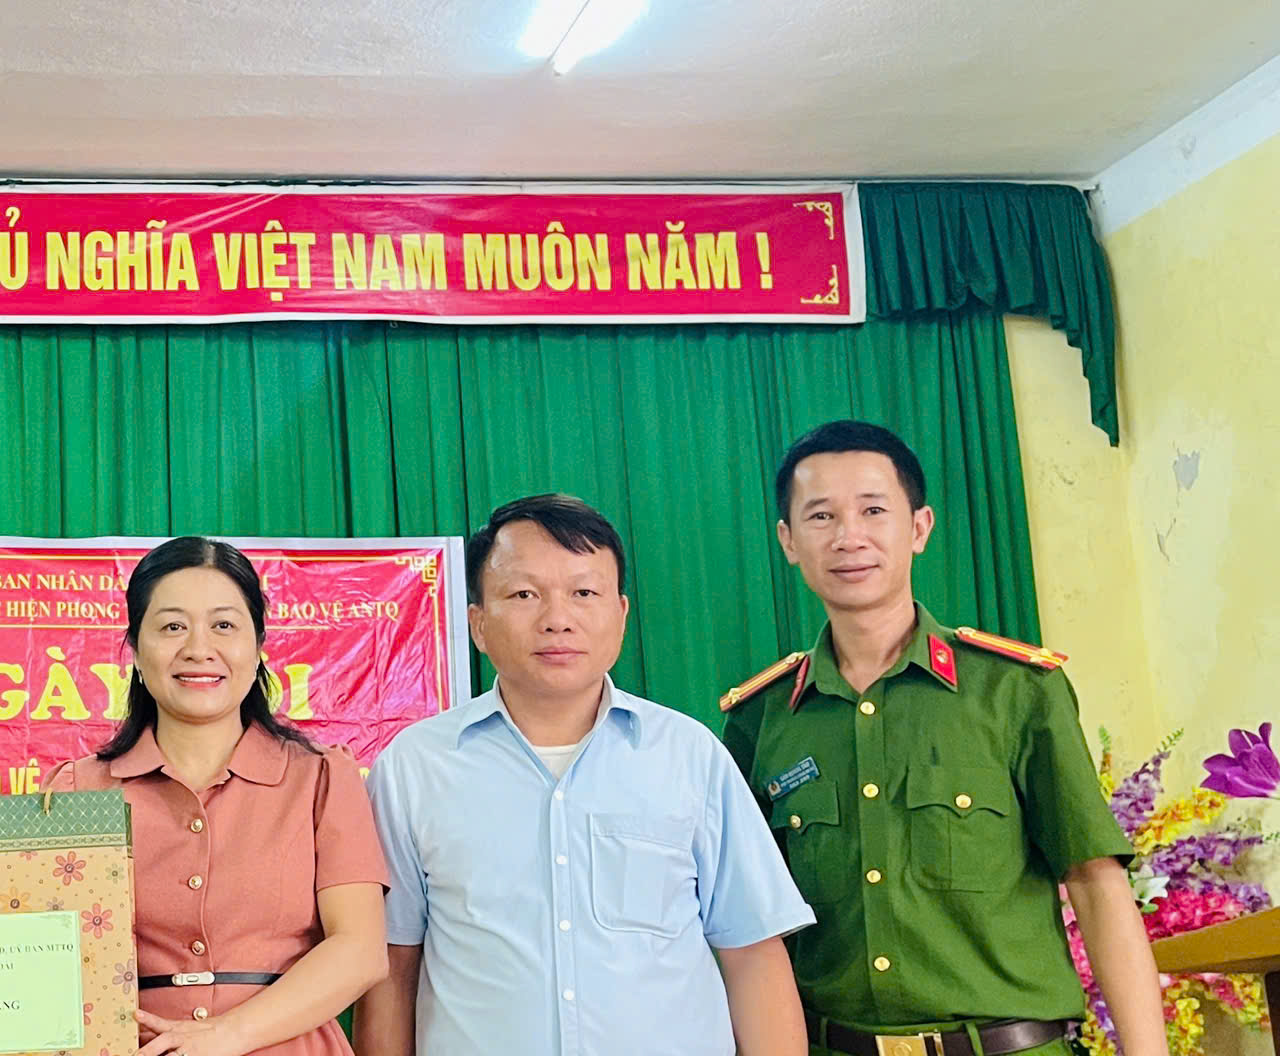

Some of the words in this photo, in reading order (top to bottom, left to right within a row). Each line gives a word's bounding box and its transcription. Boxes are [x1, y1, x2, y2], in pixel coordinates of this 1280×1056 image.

[45, 219, 200, 291] NGHĨA
[213, 221, 315, 301] VIỆT
[332, 232, 448, 291] NAM
[462, 220, 612, 292] MUÔN
[626, 223, 743, 291] NĂM
[756, 231, 774, 290] !
[36, 570, 94, 592] NHÂN
[98, 571, 128, 592] DÂ
[6, 597, 51, 623] HIỆN
